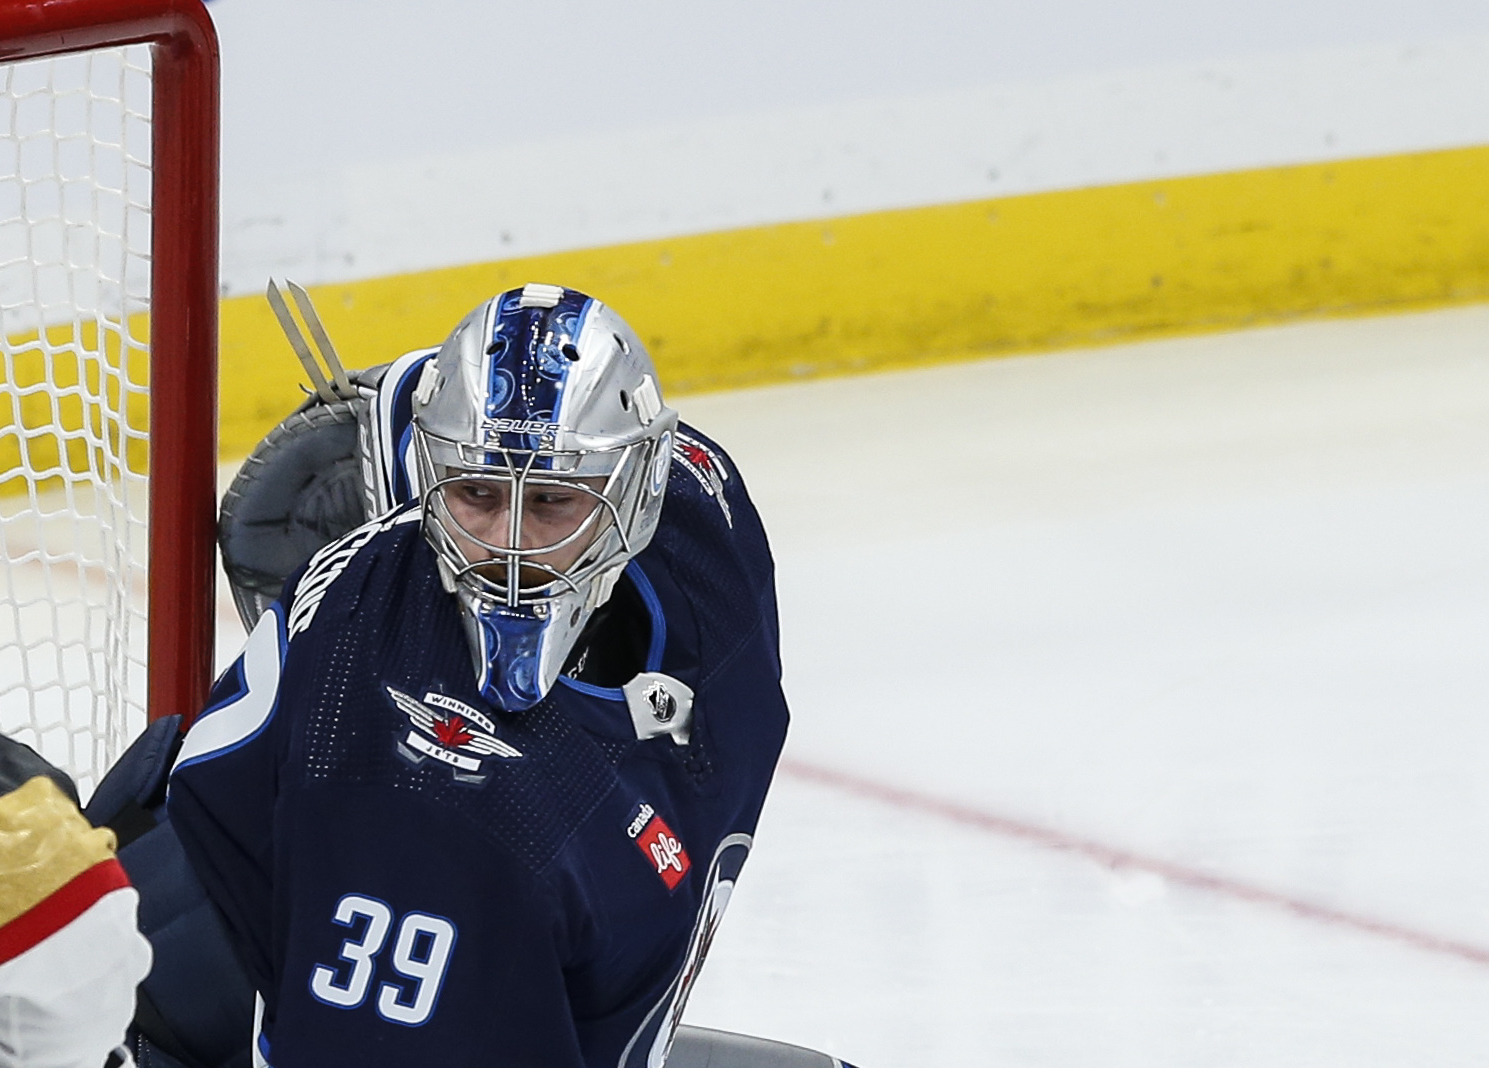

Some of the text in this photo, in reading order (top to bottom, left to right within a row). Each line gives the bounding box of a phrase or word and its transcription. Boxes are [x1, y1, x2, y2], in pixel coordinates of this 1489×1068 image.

[424, 745, 460, 765] JETS
[627, 803, 655, 839] canada
[650, 832, 682, 874] life
[309, 892, 458, 1028] 39
